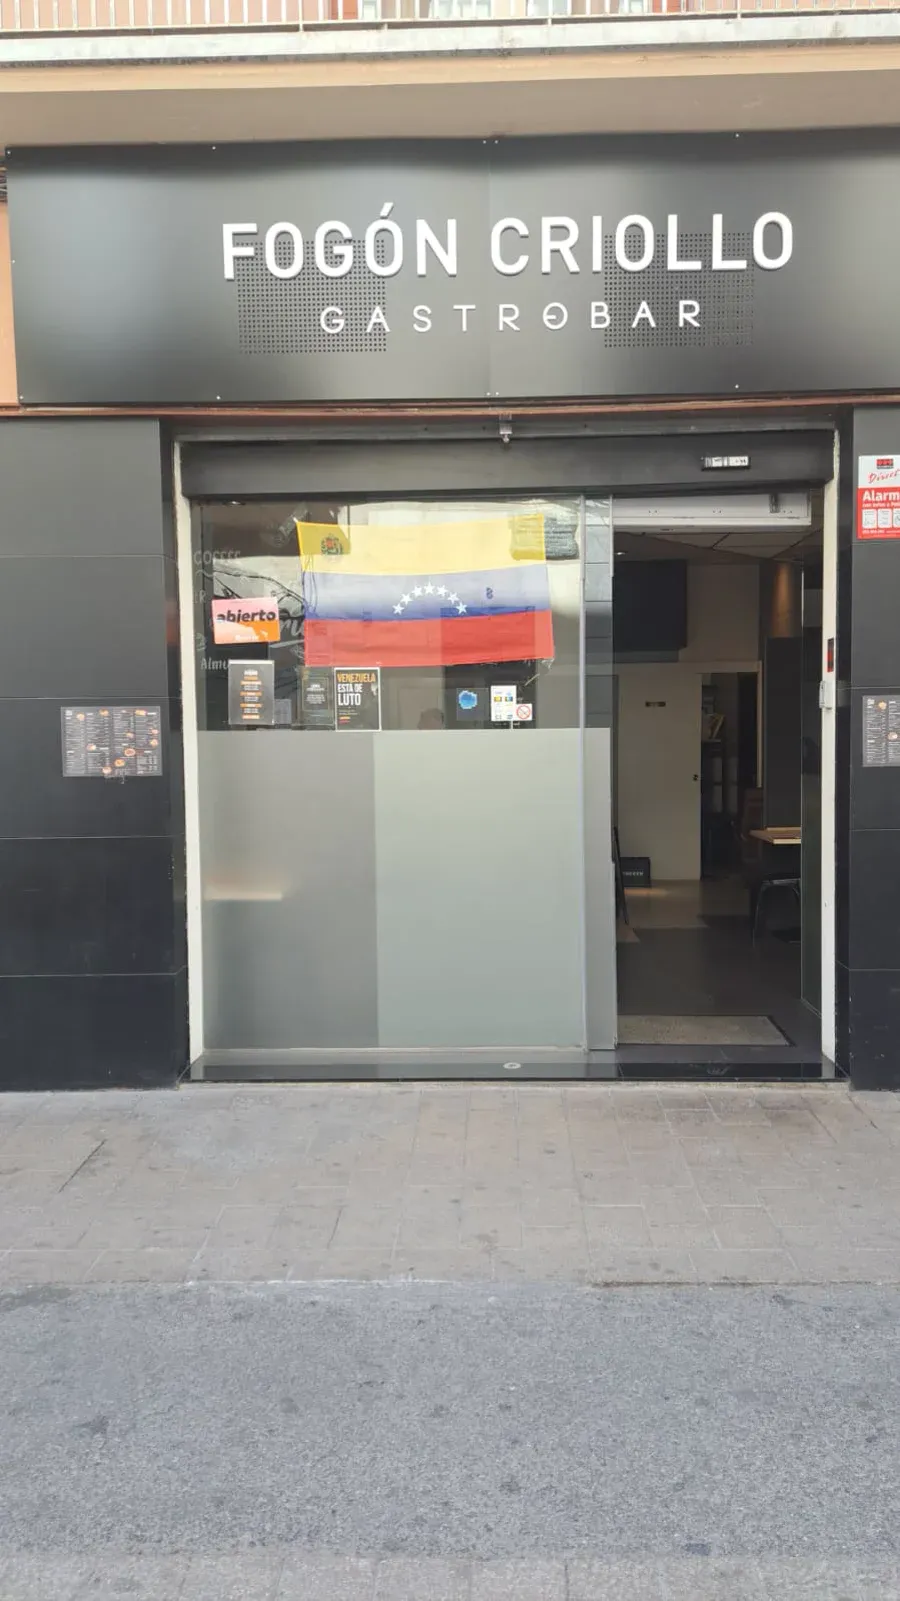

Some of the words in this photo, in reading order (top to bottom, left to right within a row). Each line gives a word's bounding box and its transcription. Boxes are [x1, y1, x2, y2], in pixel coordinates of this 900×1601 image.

[223, 202, 458, 280] FOGÓN
[491, 211, 793, 275] CRIOLLO
[320, 299, 701, 334] GASTROBAR
[217, 609, 276, 623] abierto
[200, 656, 229, 671] Almu
[337, 672, 376, 683] VENEZUELA
[354, 683, 363, 693] DE
[338, 693, 362, 707] LUTO
